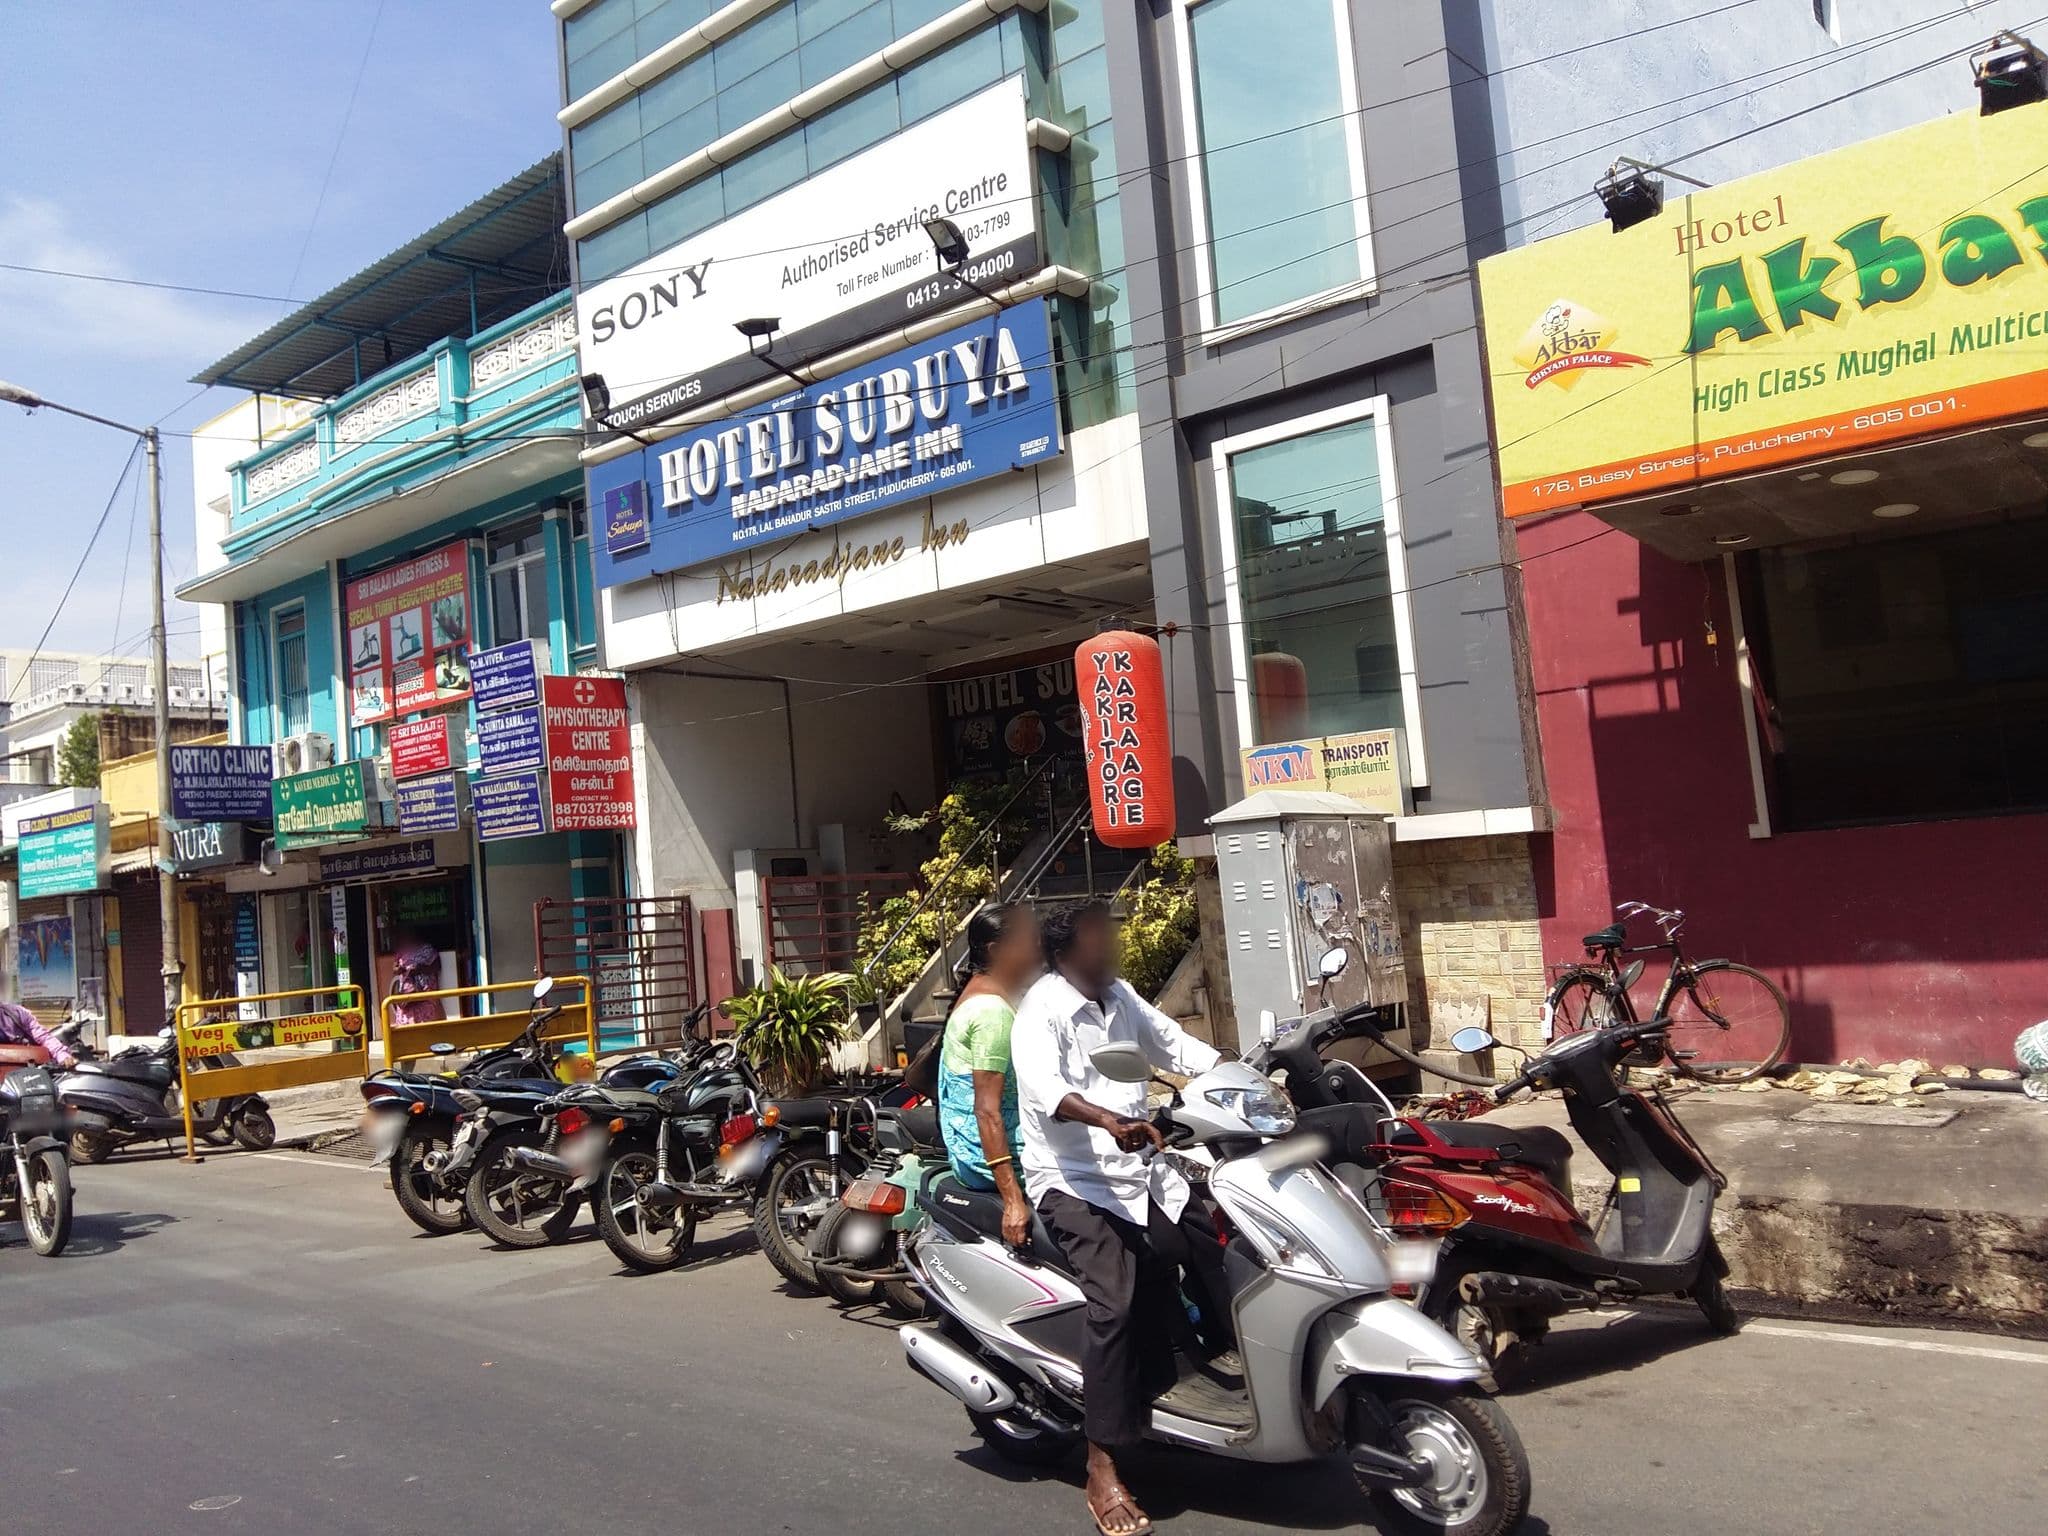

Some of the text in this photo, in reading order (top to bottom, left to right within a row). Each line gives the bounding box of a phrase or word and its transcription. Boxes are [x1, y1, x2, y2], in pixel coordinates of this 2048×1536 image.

[781, 172, 1007, 289] Authorised Service Centre
[1672, 195, 1789, 256] Hotel
[837, 278, 854, 297] Toll
[857, 272, 879, 289] Free
[882, 253, 922, 277] Number
[591, 257, 713, 345] SONY
[907, 282, 940, 308] 0413
[1534, 329, 1601, 365] Akbar
[1530, 354, 1612, 384] BIRYANI PALACE
[1694, 377, 1748, 413] High
[1758, 362, 1826, 398] Class
[1836, 332, 1936, 376] Mughal
[646, 379, 701, 414] SERVICES
[658, 327, 1030, 507] HOTEL SUBUYA
[1532, 479, 1575, 497] 176,
[1579, 468, 1636, 488] Bussy
[1639, 451, 1710, 475] Street,
[1714, 425, 1836, 459] Puducherry
[1853, 407, 1904, 431] 605
[1909, 397, 1967, 418] 001.
[731, 423, 963, 518] NADARADJANE INN
[615, 509, 633, 520] HOTEL
[759, 520, 774, 534] LAL
[775, 510, 812, 529] BAHADUR
[814, 501, 842, 518] SASTRI
[844, 490, 878, 508] STREET,
[940, 466, 955, 479] 605
[716, 511, 970, 606] Nadaradjane Inn
[946, 659, 1074, 717] HOTEL SU
[398, 720, 436, 738] SRI BALAJI
[547, 706, 627, 727] PHYSIOTHERAPY
[571, 731, 611, 751] CENTRE
[1092, 653, 1121, 827] YAKITORI
[1113, 651, 1144, 826] KARAAGE
[172, 748, 269, 774] ORTHO CLINIC
[552, 755, 629, 775] பிசியோதெரபி
[1246, 741, 1390, 786] NKM TRANSPORT
[179, 789, 267, 799] ORTHO PAEDIC SURGEON
[312, 773, 340, 788] MEDICALS
[570, 775, 614, 791] சென்டர்
[555, 801, 633, 816] 8870373998
[556, 813, 634, 828] 9677686341
[173, 826, 223, 862] NURA
[192, 1028, 224, 1041] Veg
[279, 1013, 333, 1029] Chicken
[283, 1028, 331, 1044] Briyani
[184, 1042, 235, 1058] Meals
[1472, 1194, 1512, 1211] Scooty
[930, 1254, 968, 1293] Pleasure
